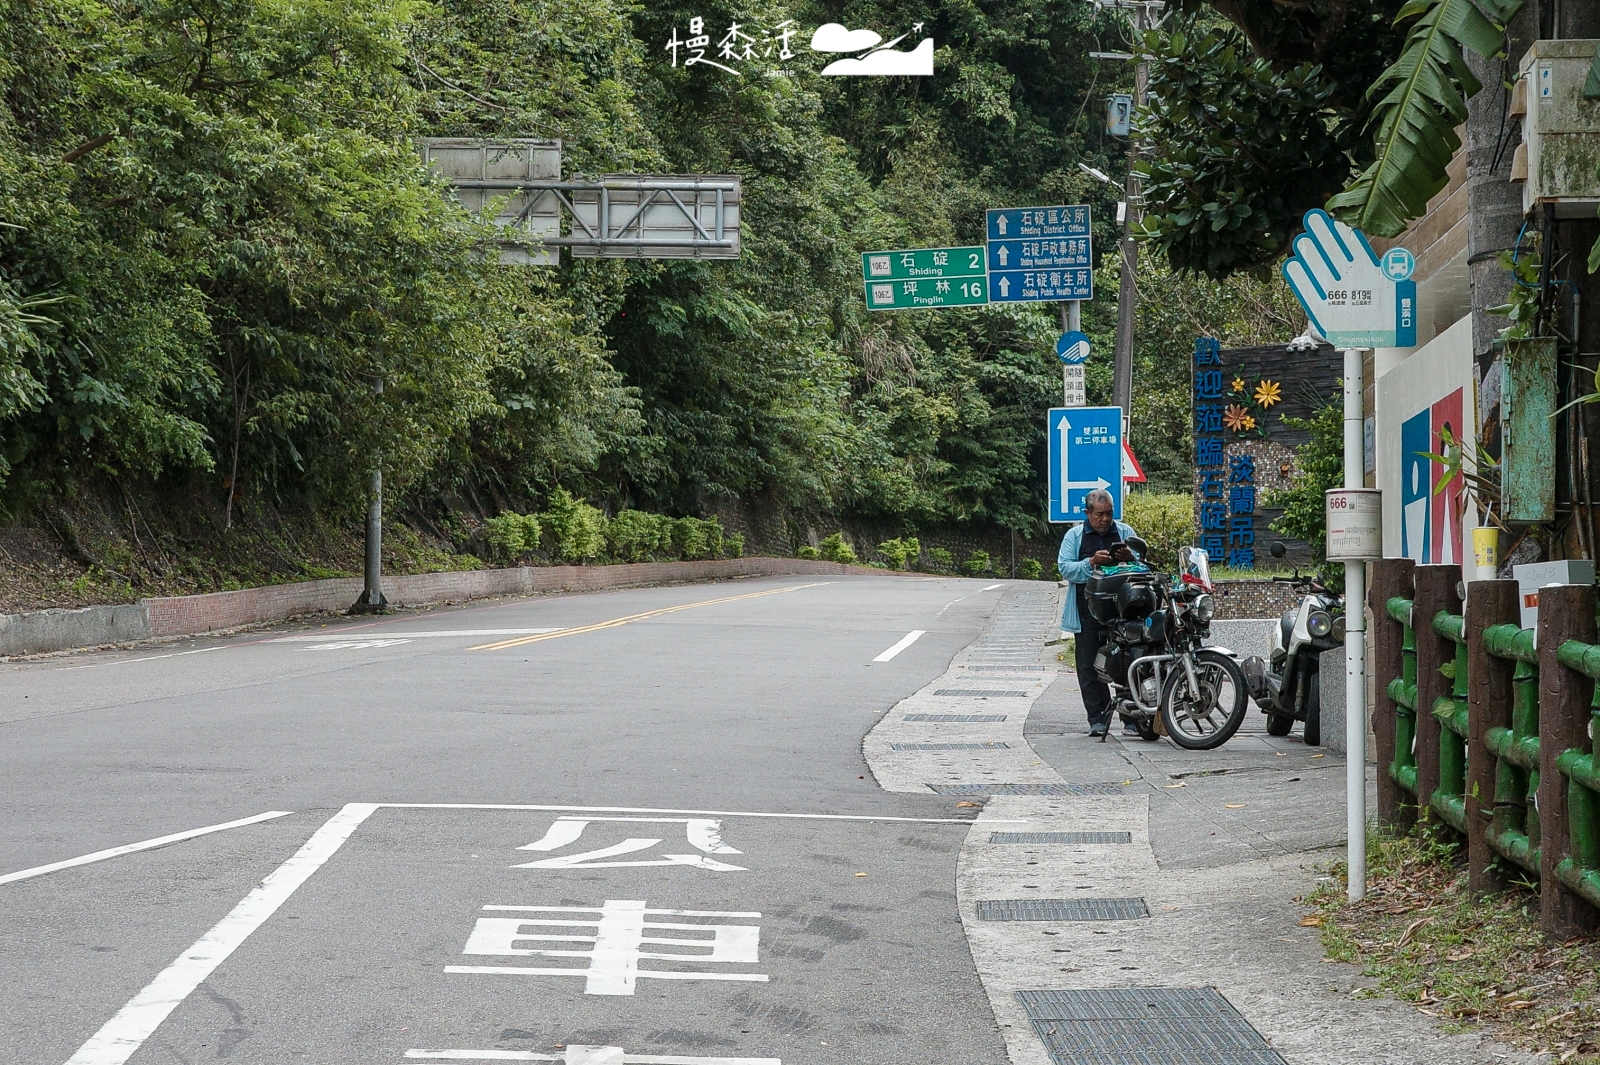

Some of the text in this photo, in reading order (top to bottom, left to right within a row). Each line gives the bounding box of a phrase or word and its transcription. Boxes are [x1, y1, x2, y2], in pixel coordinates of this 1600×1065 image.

[1021, 208, 1085, 226] 石碇區公所
[1020, 225, 1086, 236] Shiding District Office
[968, 253, 980, 269] 2
[908, 267, 943, 276] Shiding
[1023, 270, 1088, 288] 石碇衛生所
[960, 282, 982, 298] 16
[1022, 286, 1089, 299] Shiding Public Health Center
[1327, 290, 1348, 300] 666
[913, 296, 944, 305] Pinglin
[1194, 337, 1226, 562] 歡迎蒞臨石碇區
[1330, 497, 1347, 509] 666
[1228, 454, 1256, 570] 淡蘭吊橋
